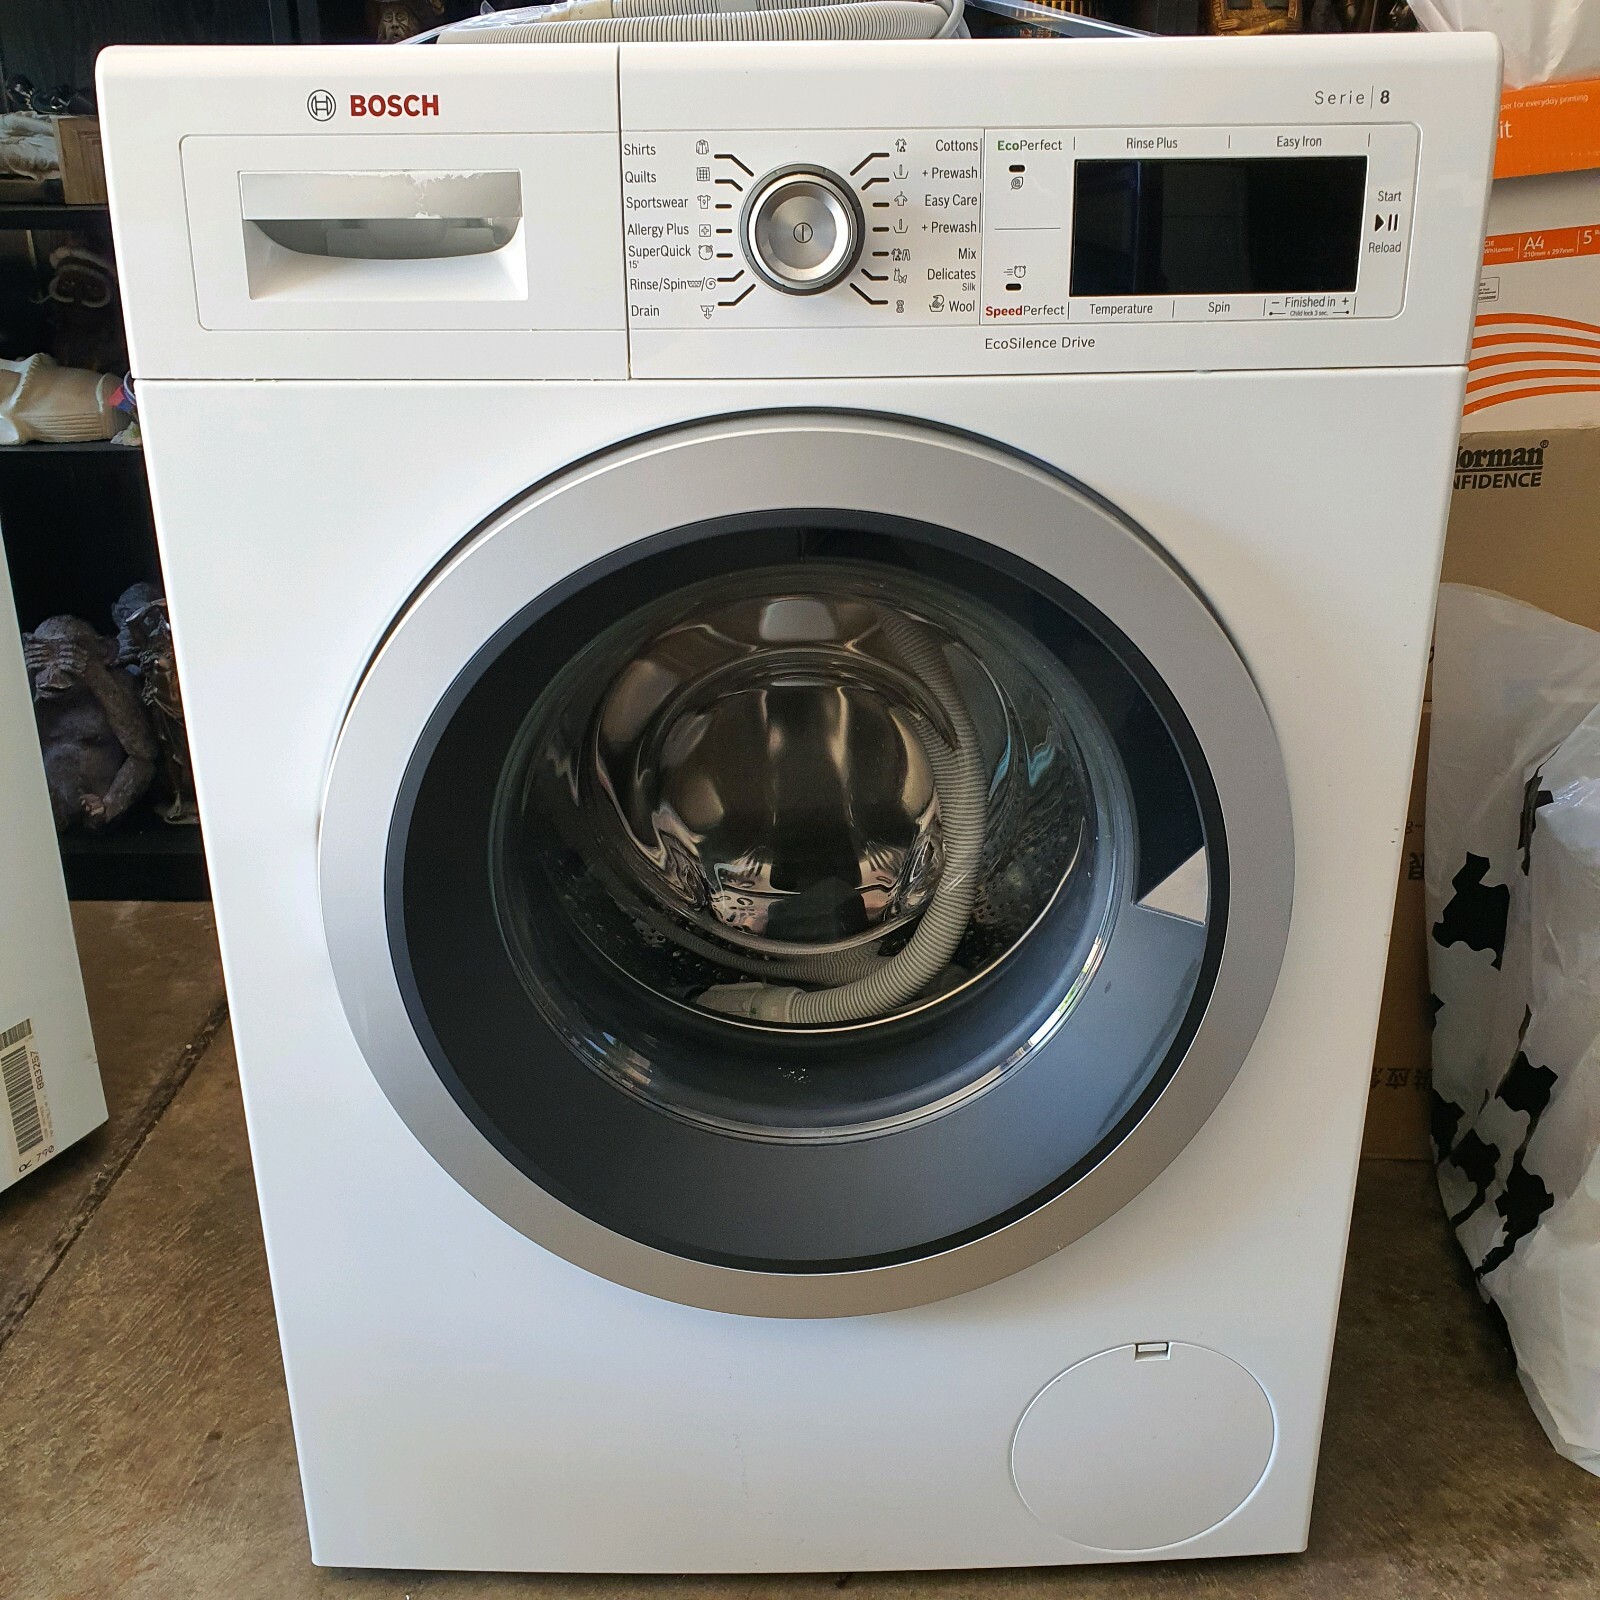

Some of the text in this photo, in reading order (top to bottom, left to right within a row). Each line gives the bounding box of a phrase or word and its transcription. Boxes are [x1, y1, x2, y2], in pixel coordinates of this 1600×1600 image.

[1314, 90, 1390, 105] Serie 8
[1525, 97, 1558, 107] everyday
[350, 94, 439, 117] BOSCH
[935, 139, 978, 152] Cottons
[997, 139, 1063, 151] EcoPerfect
[1126, 136, 1178, 149] Rinse Plus
[1276, 135, 1322, 149] Easy Iron
[623, 143, 656, 156] Shirts
[624, 170, 657, 183] Quilts
[931, 166, 978, 179] Prewash
[925, 193, 978, 209] Easy Care
[1377, 190, 1402, 202] Start
[626, 196, 688, 211] Sportswear
[627, 223, 689, 238] Allergy Plus
[931, 220, 977, 233] Prewash
[1524, 235, 1545, 251] A4
[1583, 230, 1593, 245] 5
[628, 244, 691, 259] SuperQuick
[958, 247, 977, 260] Mix
[1368, 241, 1402, 253] Reload
[927, 267, 976, 280] Delicates
[629, 277, 687, 292] Rinse/Spin
[961, 282, 976, 292] Silk
[948, 299, 976, 313] Wool
[1207, 300, 1231, 313] Spin
[1284, 296, 1326, 308] Finished
[1327, 295, 1336, 307] in
[631, 305, 660, 317] Drain
[985, 304, 1065, 319] SpeedPerfect
[1089, 302, 1153, 315] Temperature
[984, 335, 1096, 350] EcoSilence Drive
